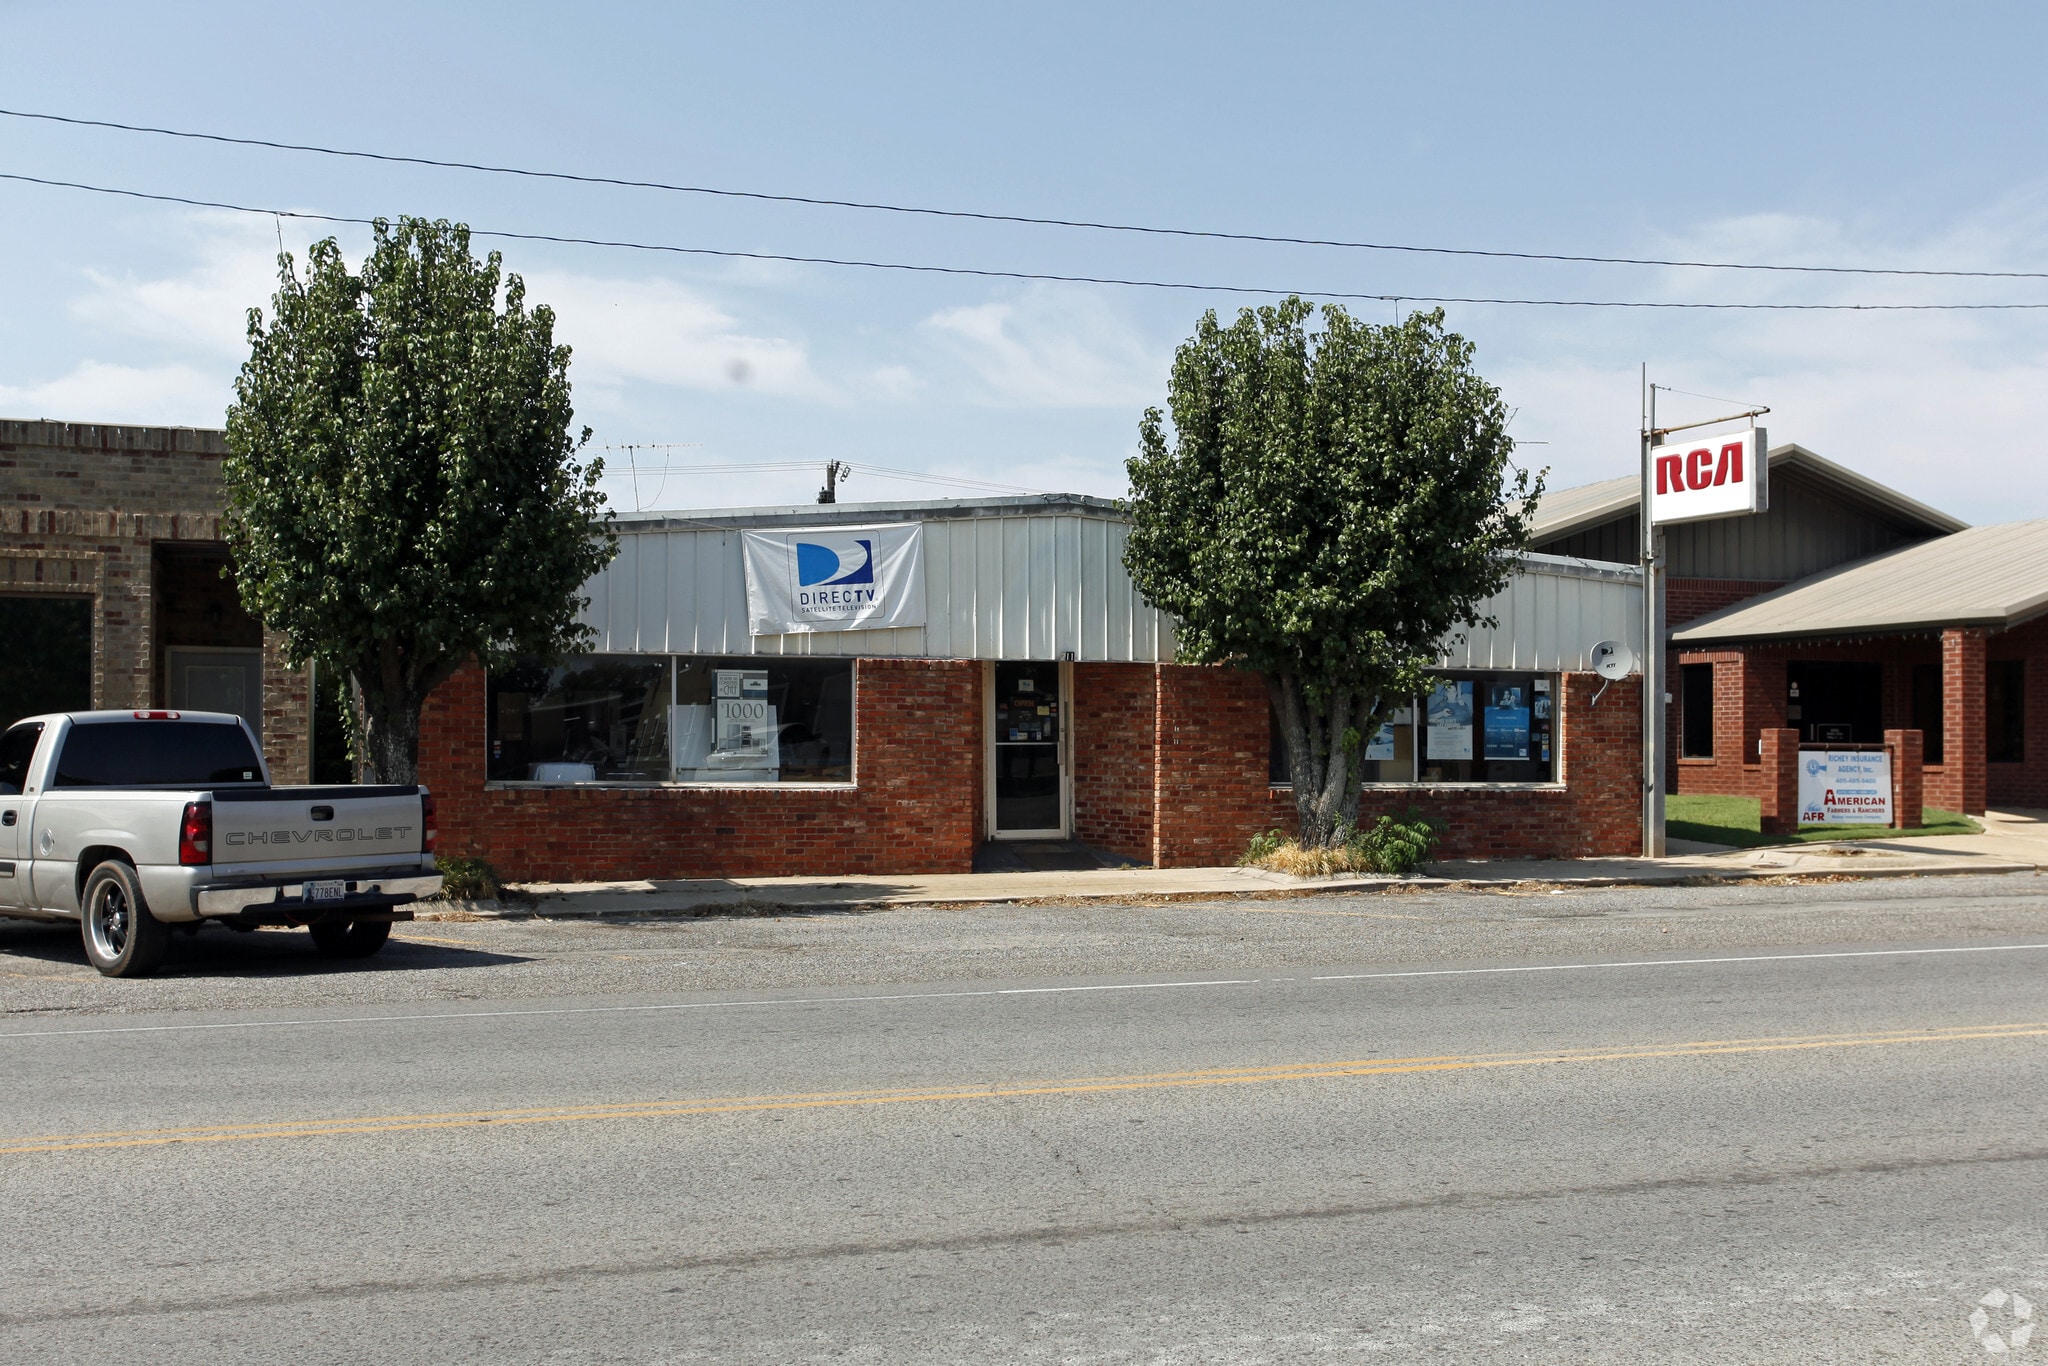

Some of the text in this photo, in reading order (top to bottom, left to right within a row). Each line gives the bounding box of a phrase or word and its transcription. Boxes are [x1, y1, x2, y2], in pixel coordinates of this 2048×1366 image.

[1656, 441, 1743, 495] RCA
[800, 589, 874, 605] DIRECTV
[1824, 789, 1885, 805] AMERICAN
[1803, 813, 1824, 821] AFR
[226, 827, 412, 845] CHEVROLET
[315, 887, 343, 898] 778ENL
